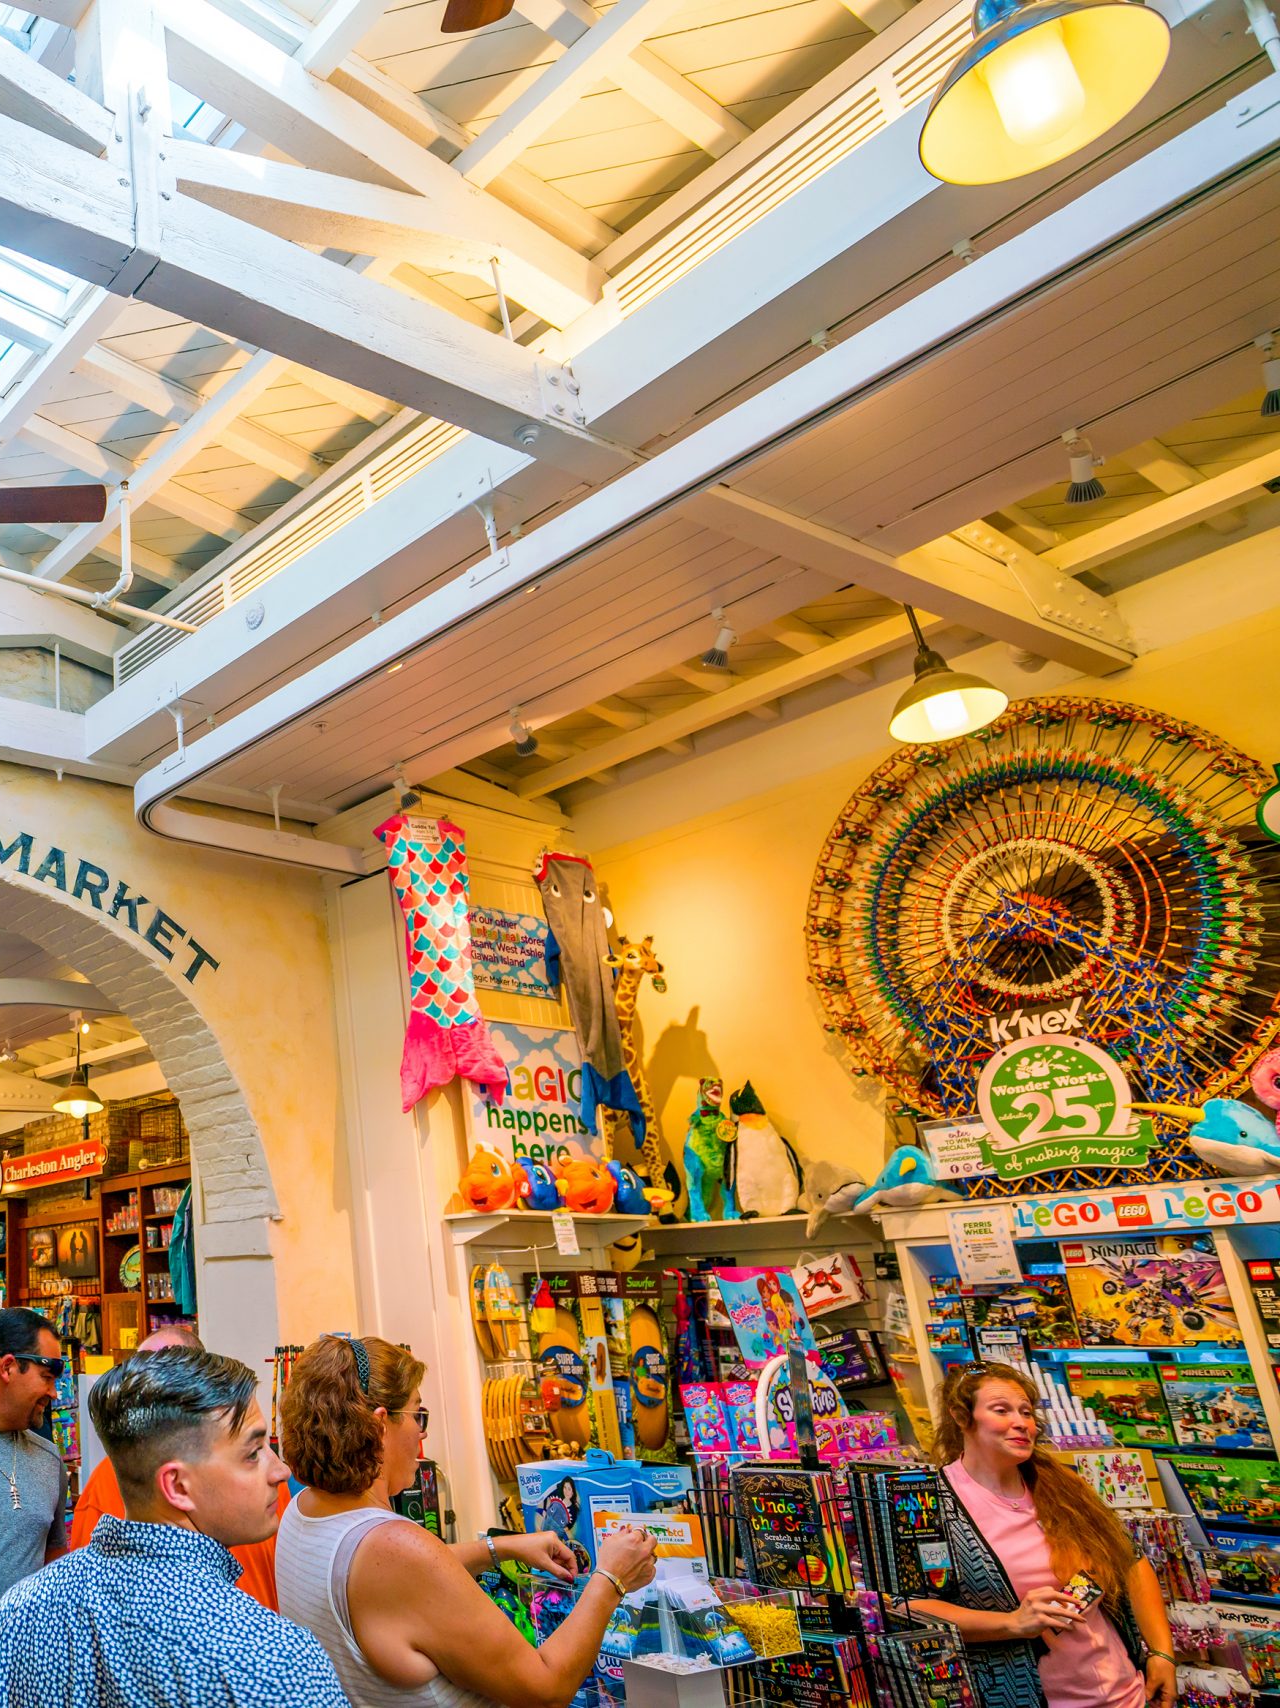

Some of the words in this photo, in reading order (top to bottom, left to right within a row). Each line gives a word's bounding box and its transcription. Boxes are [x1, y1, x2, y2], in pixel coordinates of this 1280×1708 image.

[479, 915, 493, 924] our
[495, 919, 518, 930] other
[520, 935, 546, 947] stores
[497, 942, 518, 955] West
[500, 957, 526, 968] Island
[473, 974, 488, 983] agic
[991, 1080, 1051, 1097] Wonder
[1053, 1071, 1108, 1087] Works
[485, 1100, 590, 1137] happens
[1010, 1085, 1101, 1144] 25
[1004, 1153, 1023, 1171] of
[1025, 1145, 1082, 1164] making
[1086, 1145, 1137, 1164] magic
[3, 1161, 58, 1182] Charleston
[59, 1148, 97, 1171] Angler
[1118, 1203, 1148, 1218] LEGO
[963, 1221, 993, 1229] FERRIS
[1065, 1249, 1083, 1258] LEGO
[1087, 1242, 1161, 1259] NINJAGO
[1085, 1367, 1136, 1378] MINECRAFT
[1180, 1368, 1235, 1379] MINECRAFT
[1176, 1461, 1226, 1472] MINECRAFT
[751, 1497, 806, 1515] Under
[893, 1491, 938, 1512] Bubble
[751, 1514, 780, 1532] the
[784, 1515, 816, 1533] Sea
[666, 1527, 684, 1538] Ltd
[764, 1533, 793, 1542] Scratch
[775, 1542, 801, 1551] Sketch
[1216, 1536, 1237, 1546] CITY
[922, 1549, 948, 1561] DEMO
[1241, 1613, 1270, 1625] BIRDS
[780, 1677, 812, 1689] Scratch
[814, 1683, 830, 1691] and
[793, 1687, 822, 1700] Sketch
